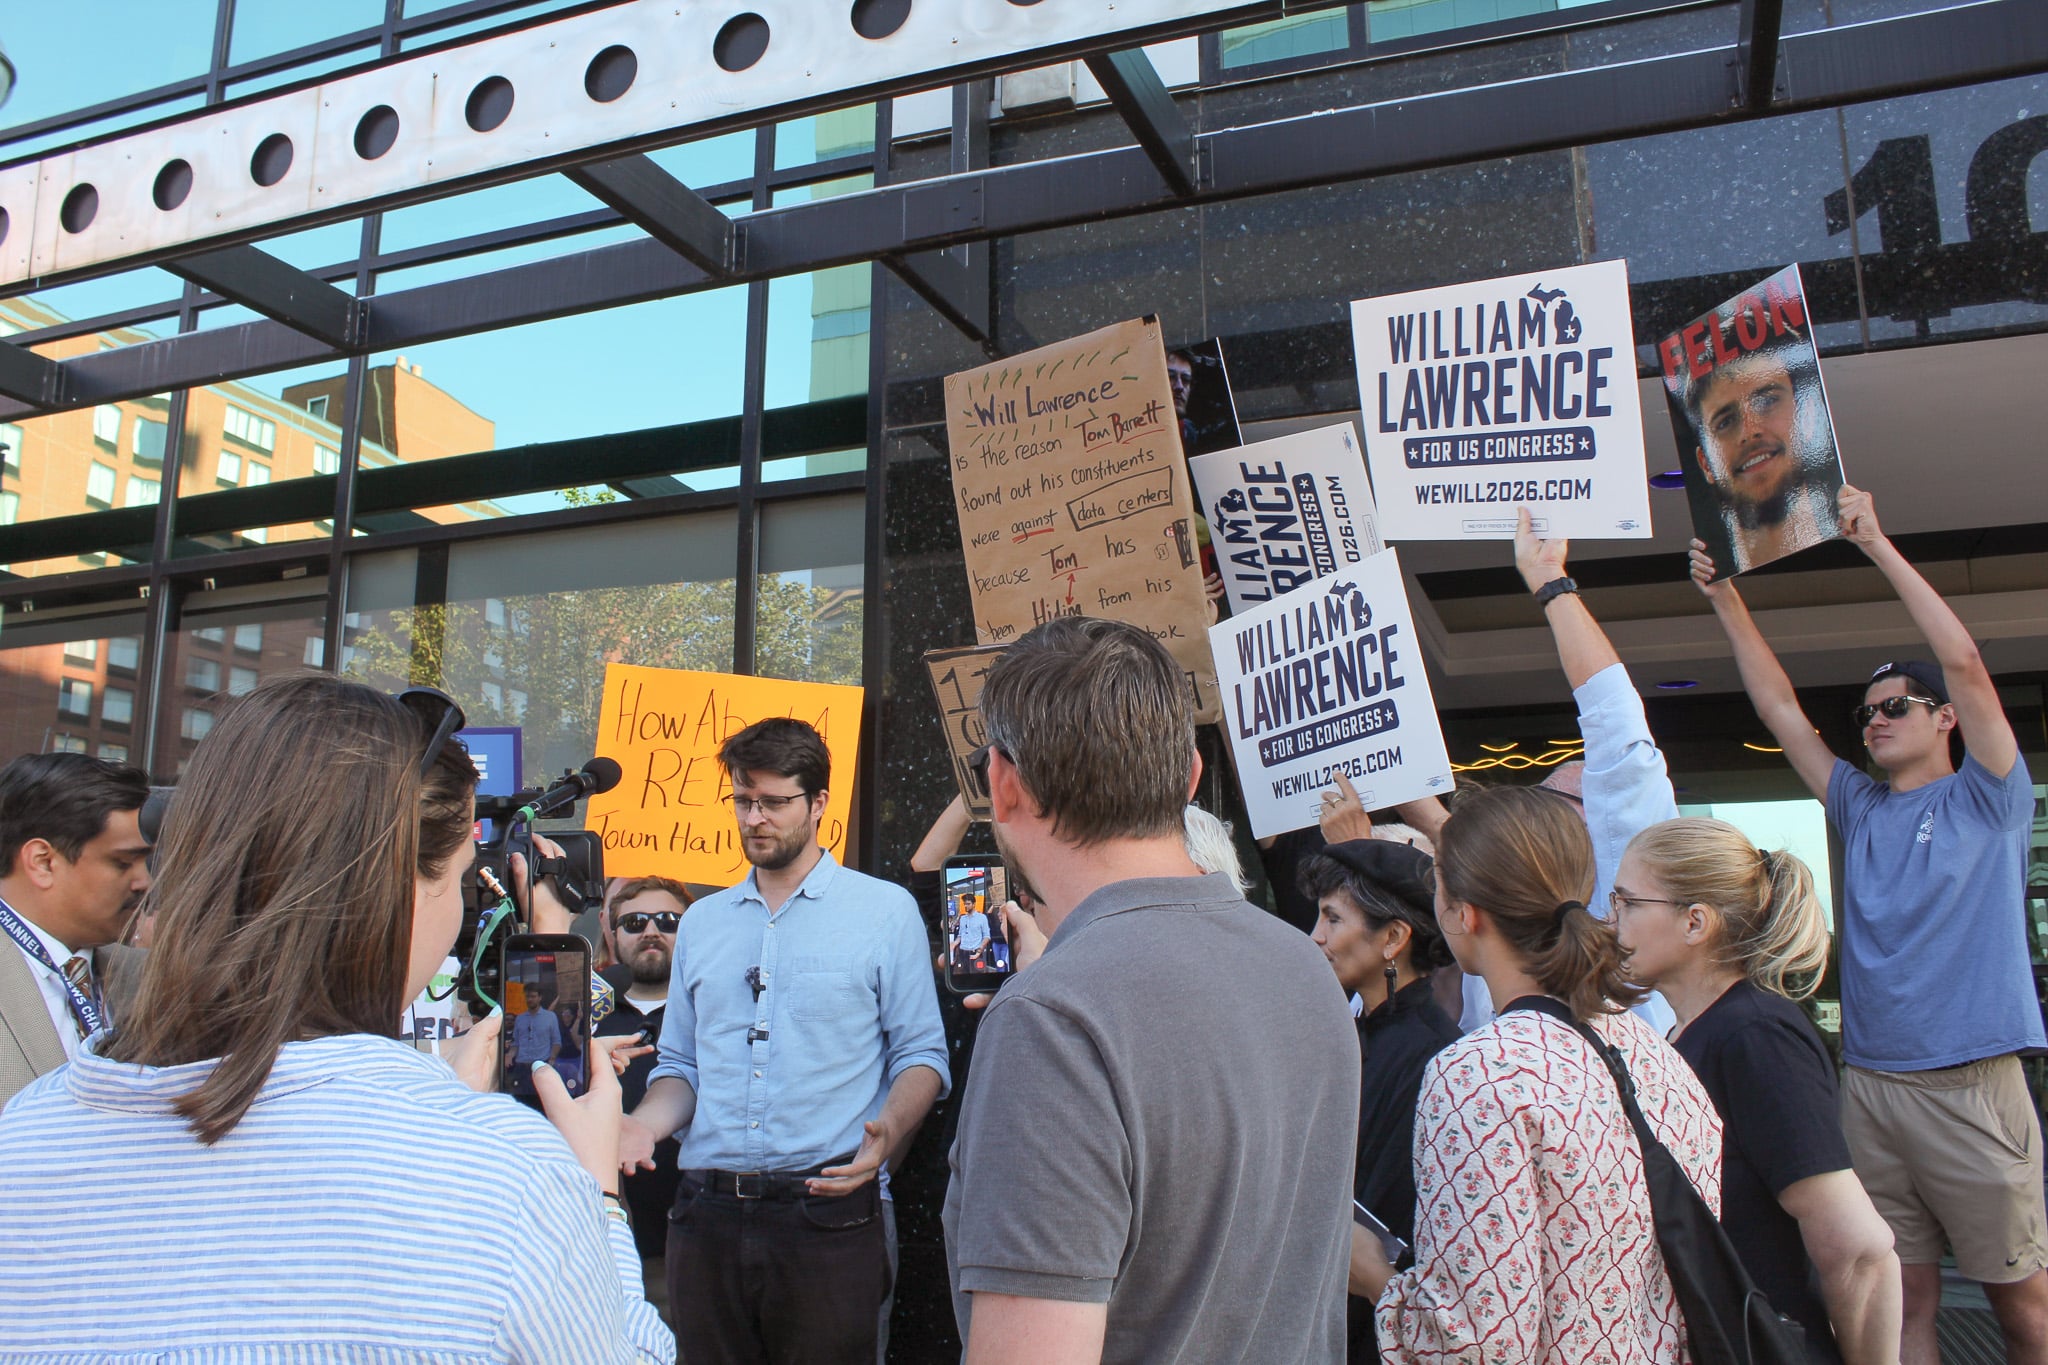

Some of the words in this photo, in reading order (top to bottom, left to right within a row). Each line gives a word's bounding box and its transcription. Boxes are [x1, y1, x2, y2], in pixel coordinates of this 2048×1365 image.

[1388, 297, 1546, 365] WILLIAM
[1659, 271, 1804, 392] FELON
[974, 393, 1017, 427] Will
[1026, 380, 1120, 418] Lawrence
[1379, 347, 1613, 433] LAWRENCE
[955, 454, 968, 471] is
[980, 443, 1010, 468] the
[1014, 438, 1062, 460] reason
[1074, 416, 1110, 448] Tom
[1107, 400, 1166, 444] Barrett
[1422, 441, 1452, 463] FOR
[1458, 438, 1479, 460] US
[1484, 433, 1574, 459] CONGRESS
[961, 486, 1002, 513] found
[1010, 478, 1032, 500] out
[1041, 473, 1064, 495] his
[1072, 448, 1155, 486] constituents
[1415, 478, 1592, 505] WEWILL2026.COM
[971, 529, 1000, 549] were
[1011, 509, 1059, 545] against
[1077, 501, 1106, 522] data
[1117, 488, 1170, 514] centers
[1239, 461, 1314, 595] RENCE
[1300, 492, 1334, 578] CONGRESS
[1325, 475, 1361, 563] 026.COM
[972, 568, 1031, 596] because
[1041, 545, 1078, 574] Tom
[1104, 534, 1137, 558] has
[1225, 519, 1273, 602] LIAM
[986, 620, 1016, 643] been
[1098, 587, 1132, 610] from
[1146, 578, 1173, 594] his
[1236, 595, 1348, 676] WILLIAM
[616, 679, 686, 746] How
[1234, 623, 1405, 740] LAWRENCE
[1272, 739, 1294, 761] FOR
[1298, 731, 1313, 752] US
[1316, 708, 1383, 747] CONGRESS
[641, 748, 733, 810] RE
[594, 810, 658, 851] Town
[0, 909, 39, 955] CHANNEL
